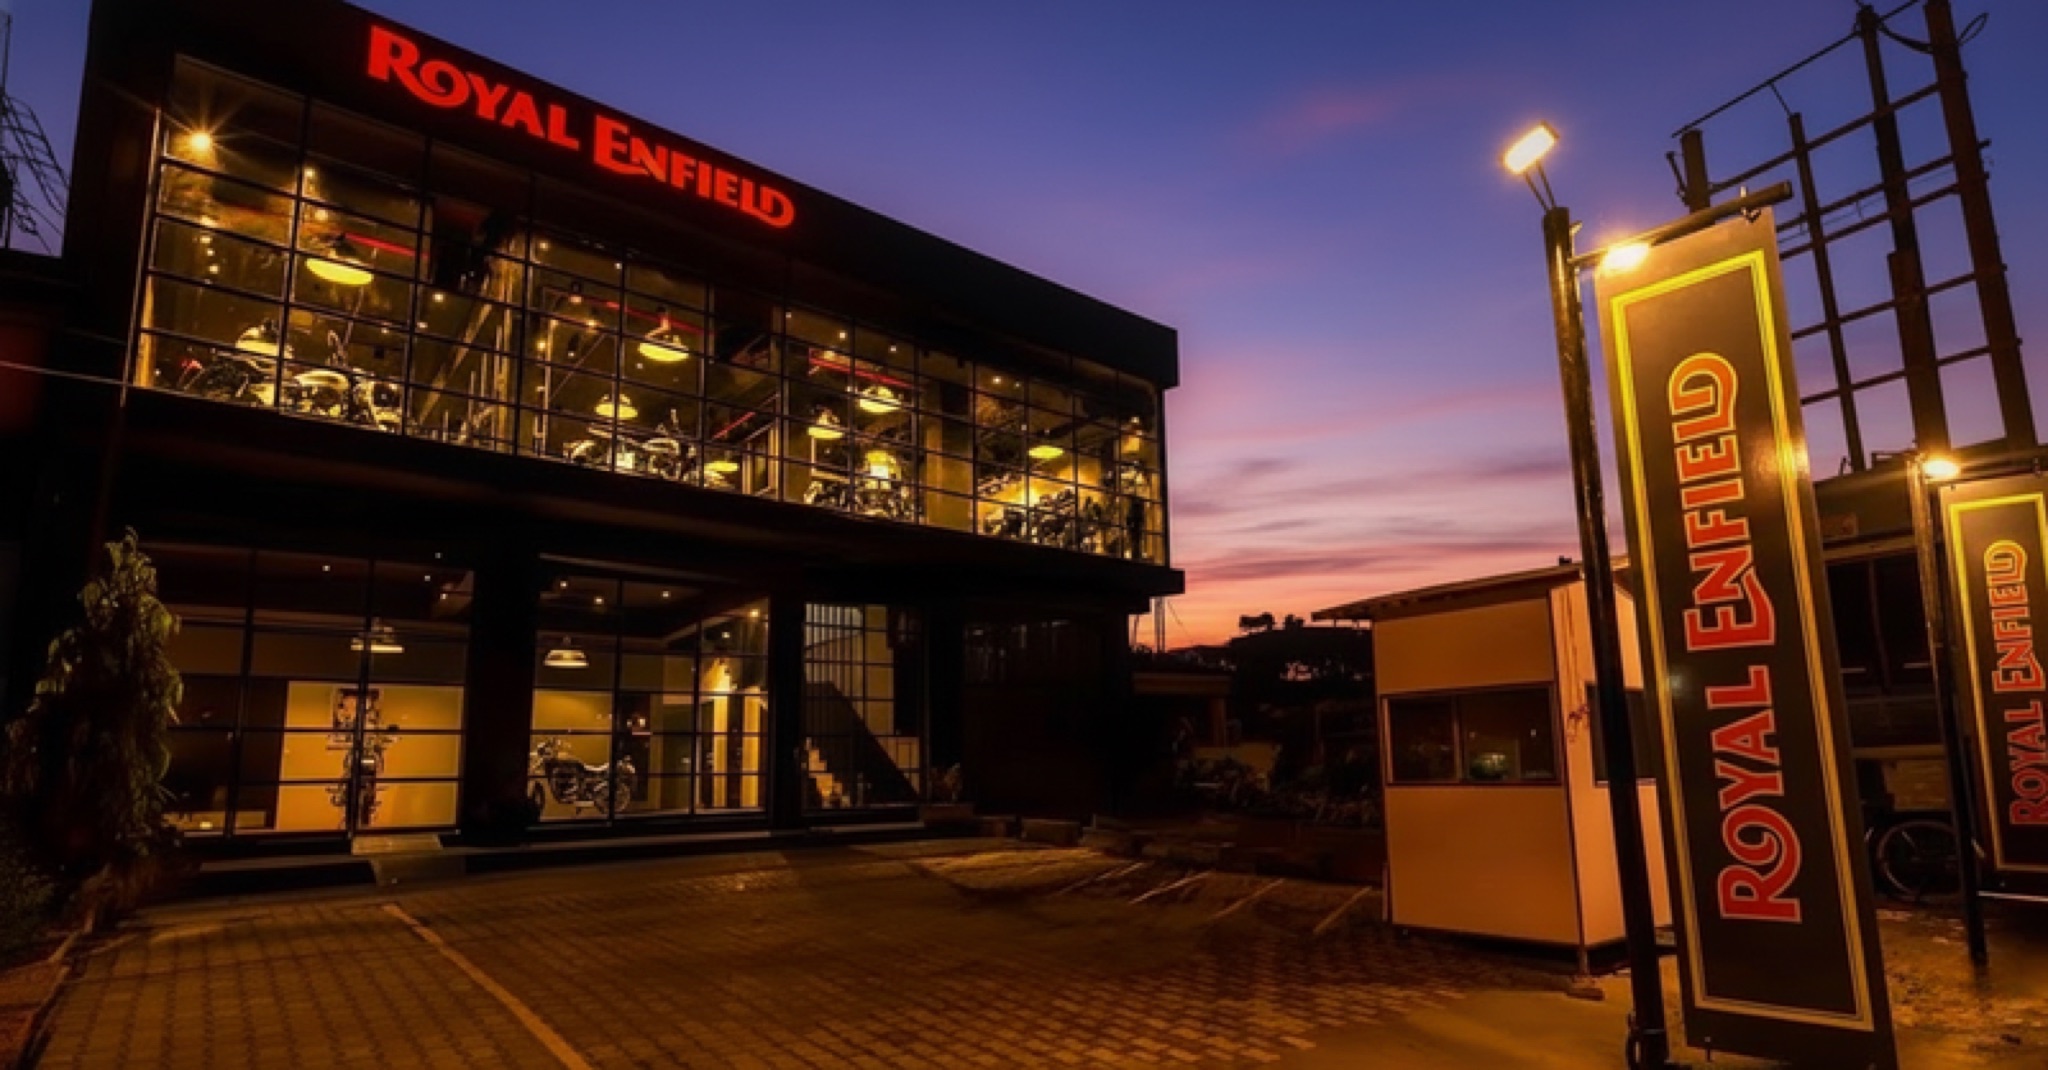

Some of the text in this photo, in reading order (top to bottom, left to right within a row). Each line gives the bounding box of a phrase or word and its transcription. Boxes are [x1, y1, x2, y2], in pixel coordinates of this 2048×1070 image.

[367, 24, 796, 229] ROYAL ENFIELD
[1668, 352, 1801, 923] ROYAL ENFIELD
[1983, 539, 2048, 825] ROYAL ENFIELD
